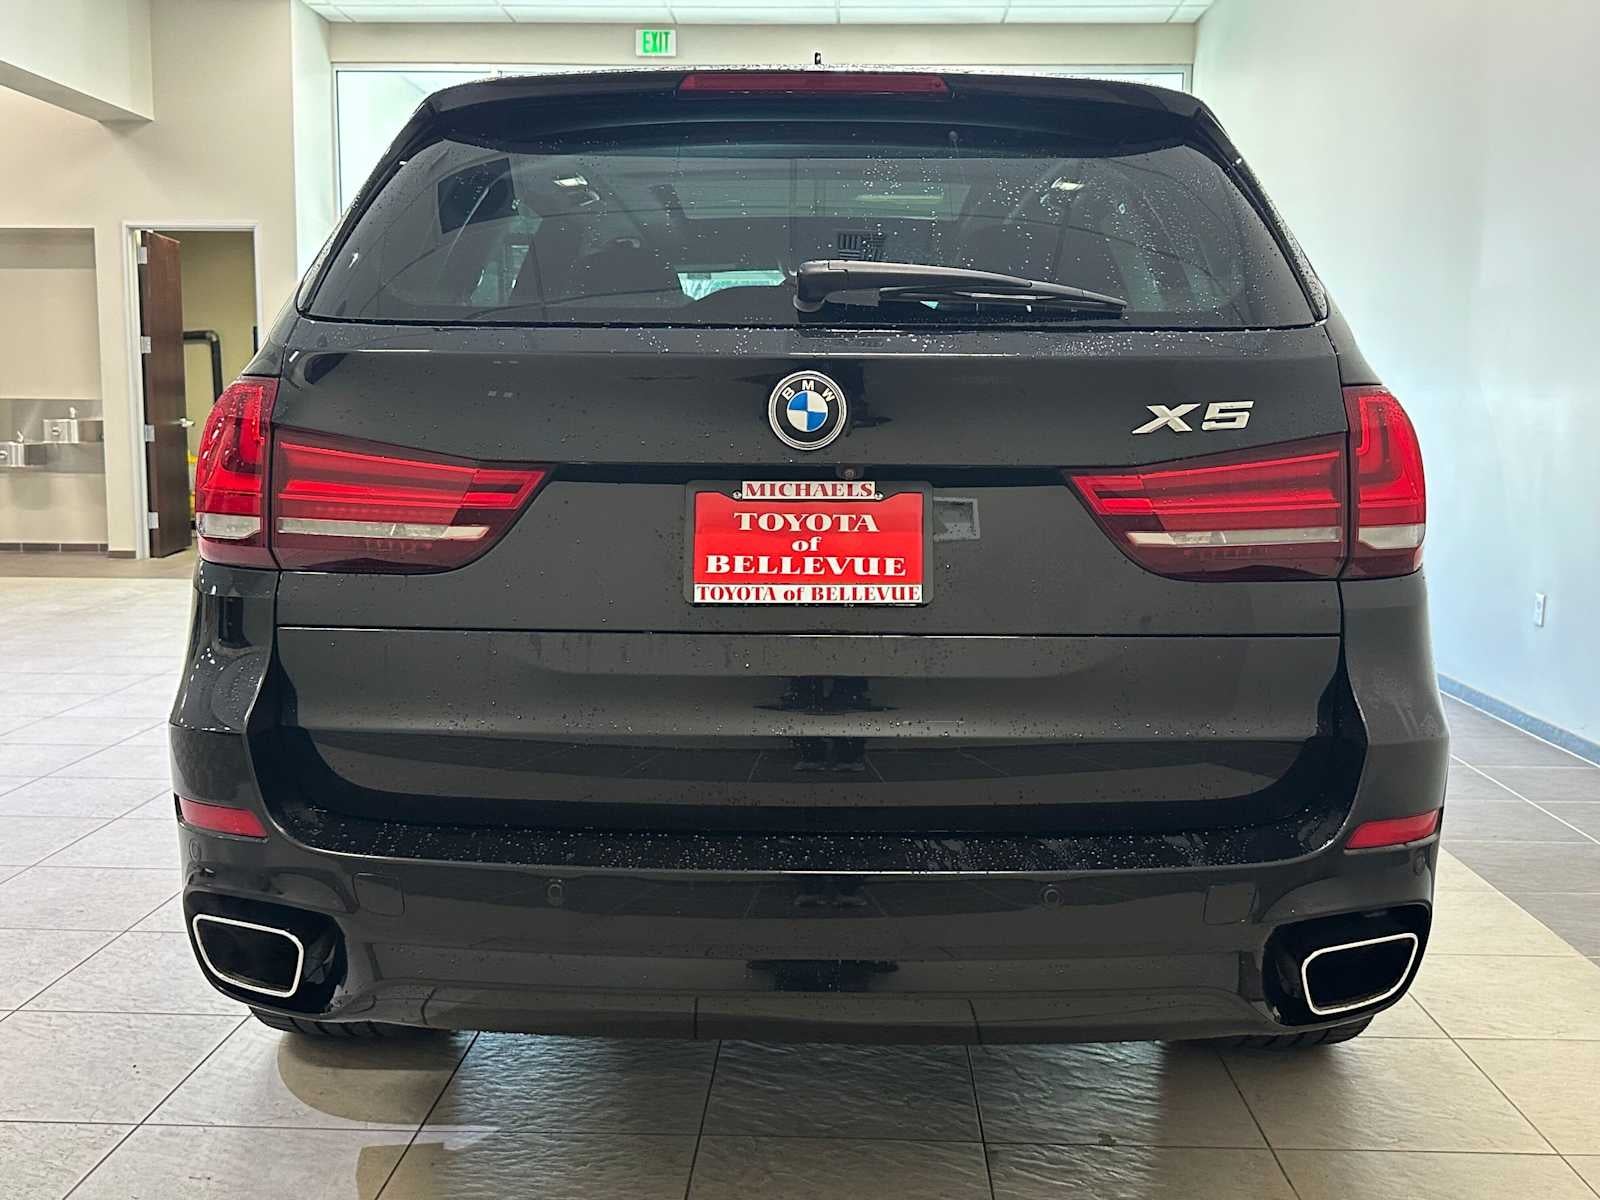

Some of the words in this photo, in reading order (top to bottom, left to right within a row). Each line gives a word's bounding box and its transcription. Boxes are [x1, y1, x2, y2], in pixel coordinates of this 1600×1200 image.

[642, 31, 671, 53] EXIT
[781, 380, 835, 402] BMW
[1132, 401, 1254, 434] X5
[745, 482, 873, 497] MICHAELS
[733, 512, 880, 532] TOYOTA
[791, 536, 822, 552] of
[705, 554, 907, 576] BELLEVUE
[696, 586, 777, 601] TOYOTA
[783, 586, 804, 601] of
[812, 586, 921, 601] BELLEVUE
